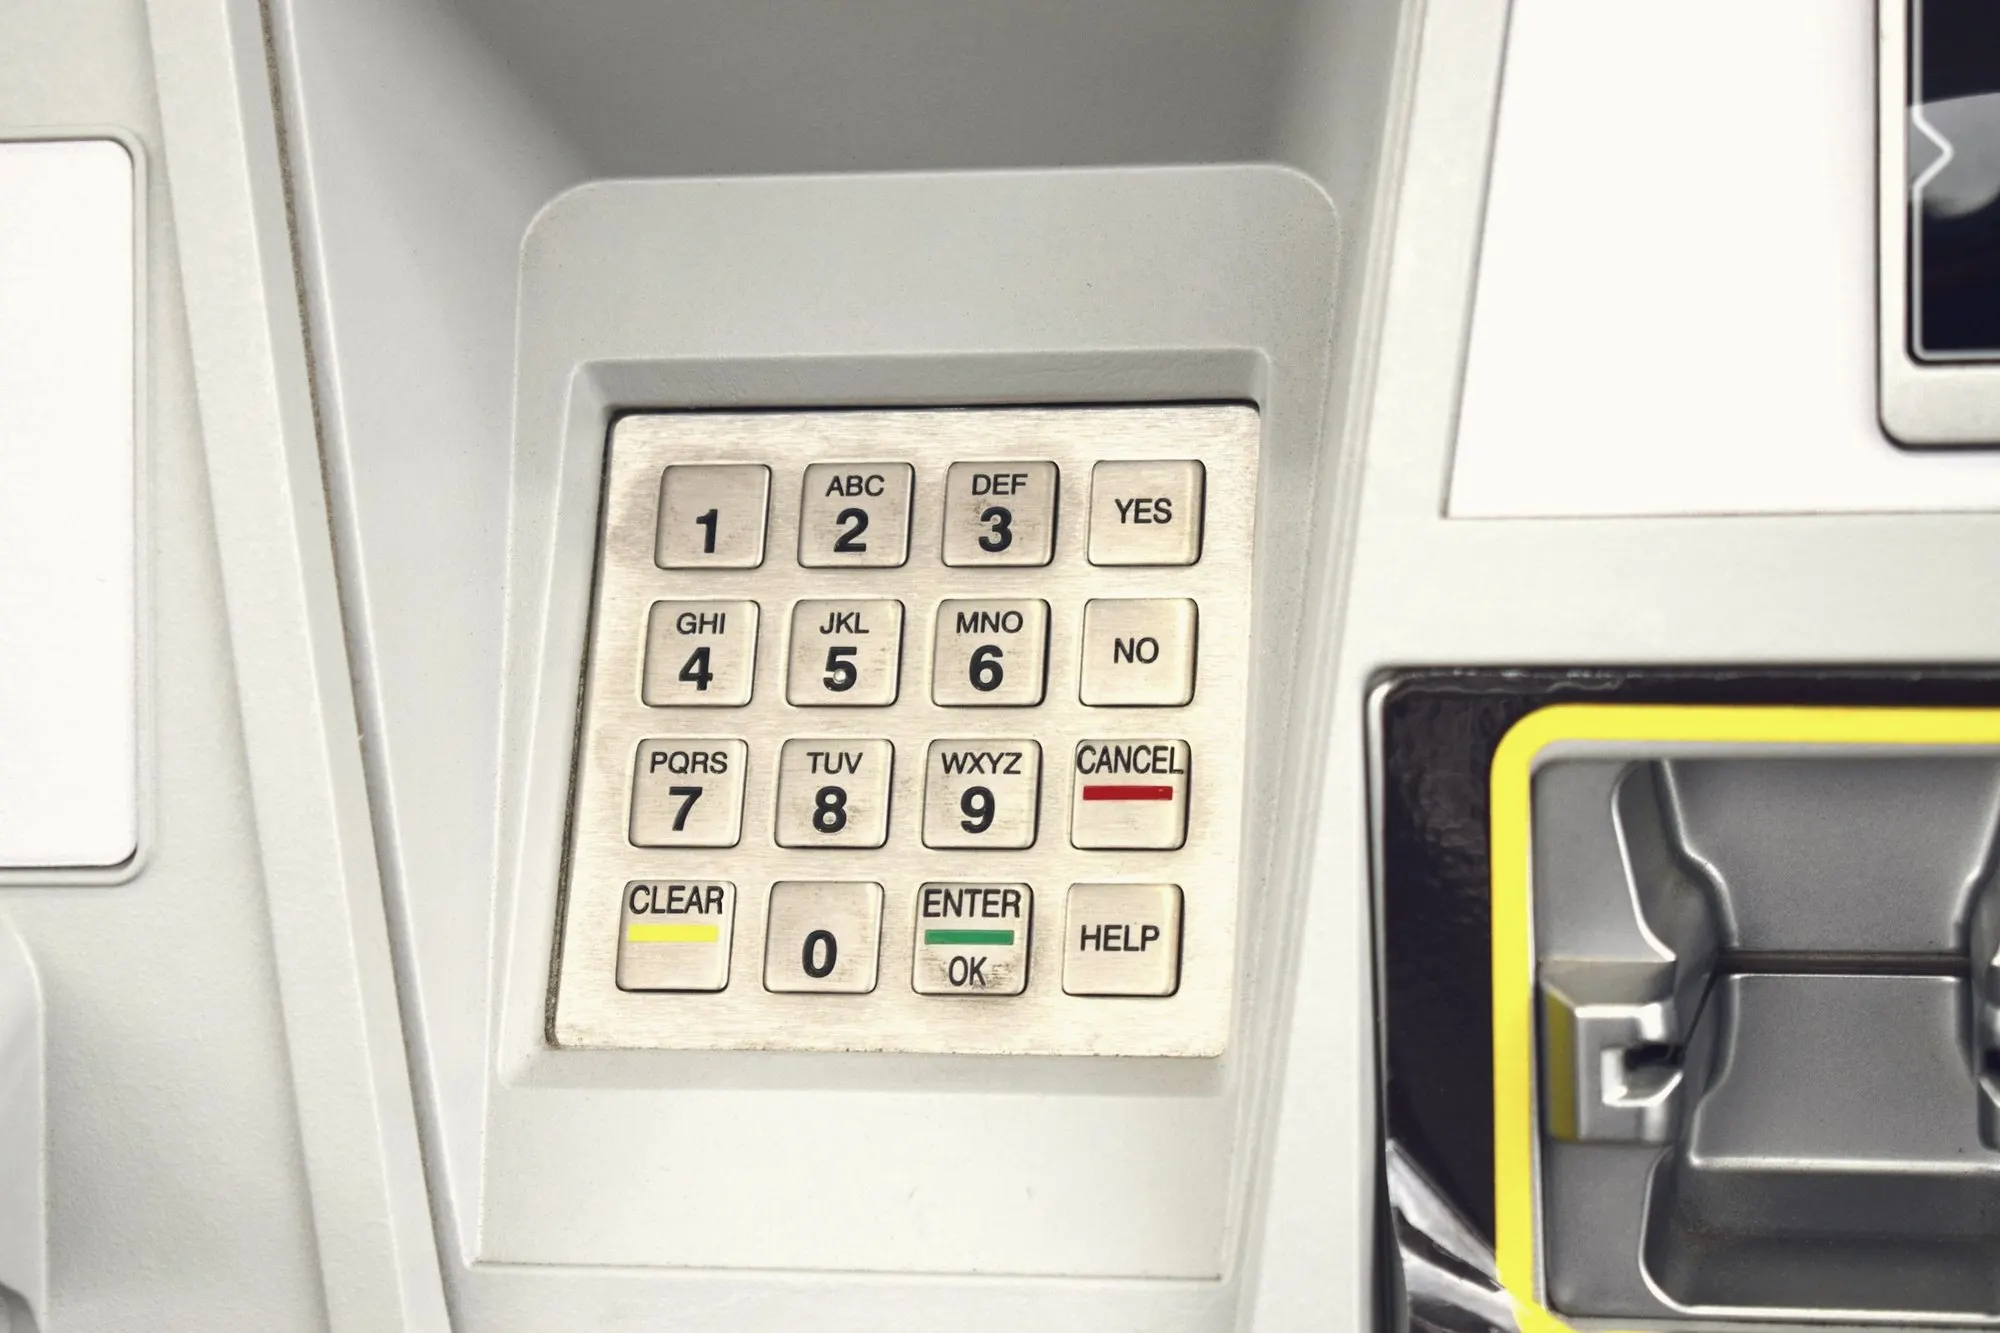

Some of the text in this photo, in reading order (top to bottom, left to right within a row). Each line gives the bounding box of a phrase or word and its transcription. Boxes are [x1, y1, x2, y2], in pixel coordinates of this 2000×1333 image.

[825, 474, 885, 497] ABC
[971, 473, 1028, 496] DEF
[1114, 497, 1172, 524] YES
[696, 508, 718, 554] 1
[833, 507, 869, 553] 2
[978, 506, 1013, 553] 3
[676, 612, 726, 635] GHI
[819, 611, 870, 635] JKL
[956, 610, 1024, 634] MNO
[1113, 637, 1159, 664] NO
[679, 646, 713, 691] 4
[823, 646, 858, 692] 5
[969, 644, 1004, 692] 6
[650, 751, 728, 775] PQRS
[806, 752, 863, 775] TUV
[941, 752, 1023, 775] WXYZ
[1076, 745, 1185, 775] CANCEL
[669, 786, 703, 831] 7
[812, 785, 847, 834] 8
[960, 786, 995, 834] 9
[629, 884, 724, 915] CLEAR
[923, 888, 1021, 918] ENTER
[1080, 924, 1160, 952] HELP
[802, 929, 838, 978] 0
[948, 955, 987, 987] OK
